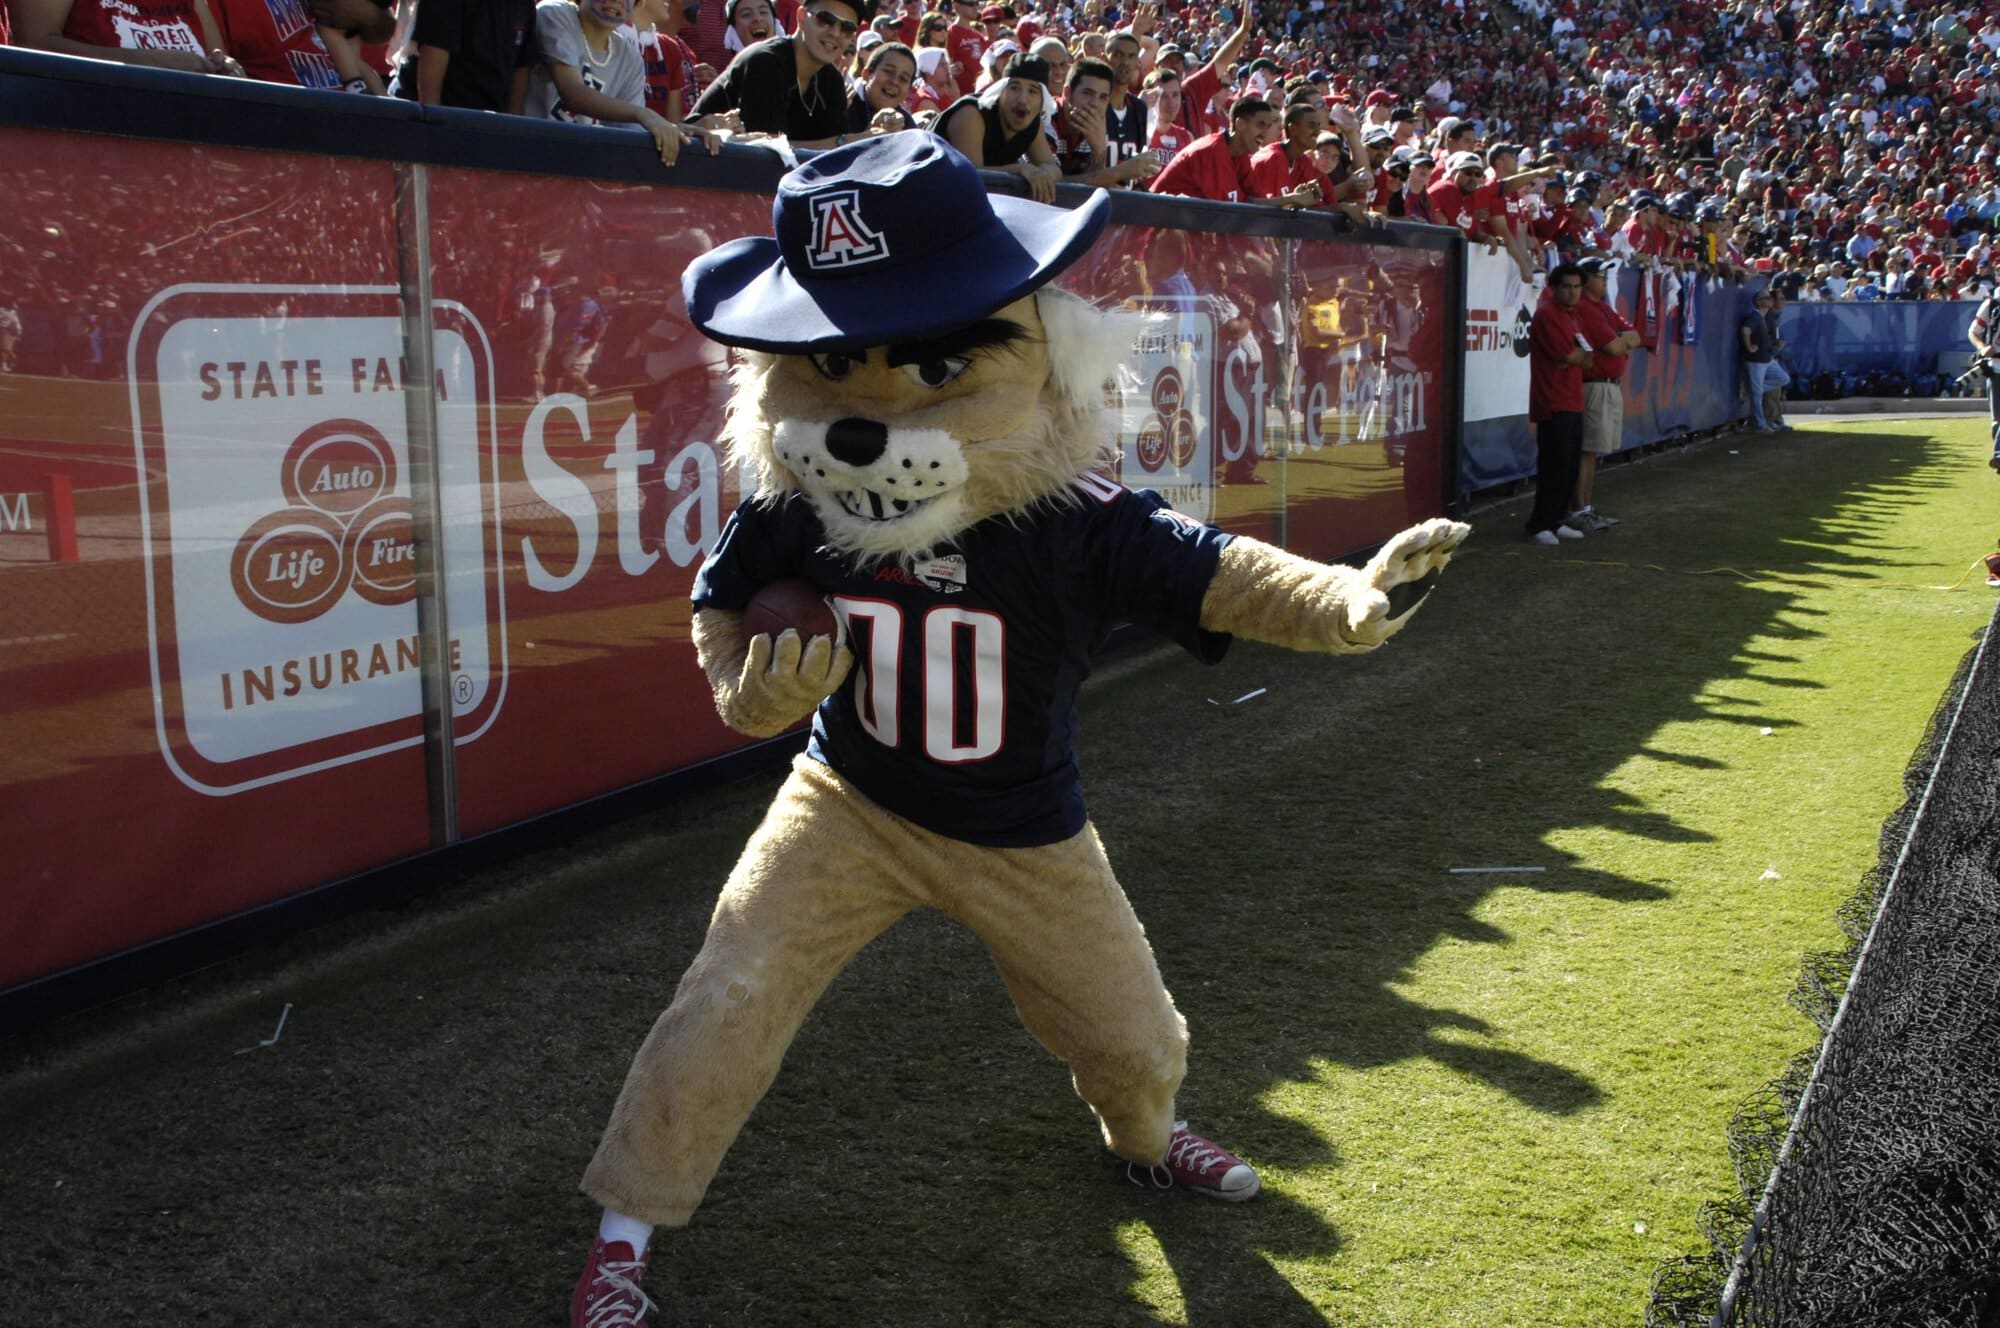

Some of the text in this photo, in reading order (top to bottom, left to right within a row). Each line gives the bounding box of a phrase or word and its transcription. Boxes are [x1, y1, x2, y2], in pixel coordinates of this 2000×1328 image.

[152, 28, 191, 45] RED
[805, 189, 890, 270] A
[1465, 309, 1498, 351] ESPN
[200, 359, 324, 401] STATE
[309, 463, 376, 493] Auto
[521, 391, 757, 593] Sta
[266, 536, 416, 590] Life Fire
[220, 633, 462, 710] INSURANE
[833, 593, 1007, 765] 00
